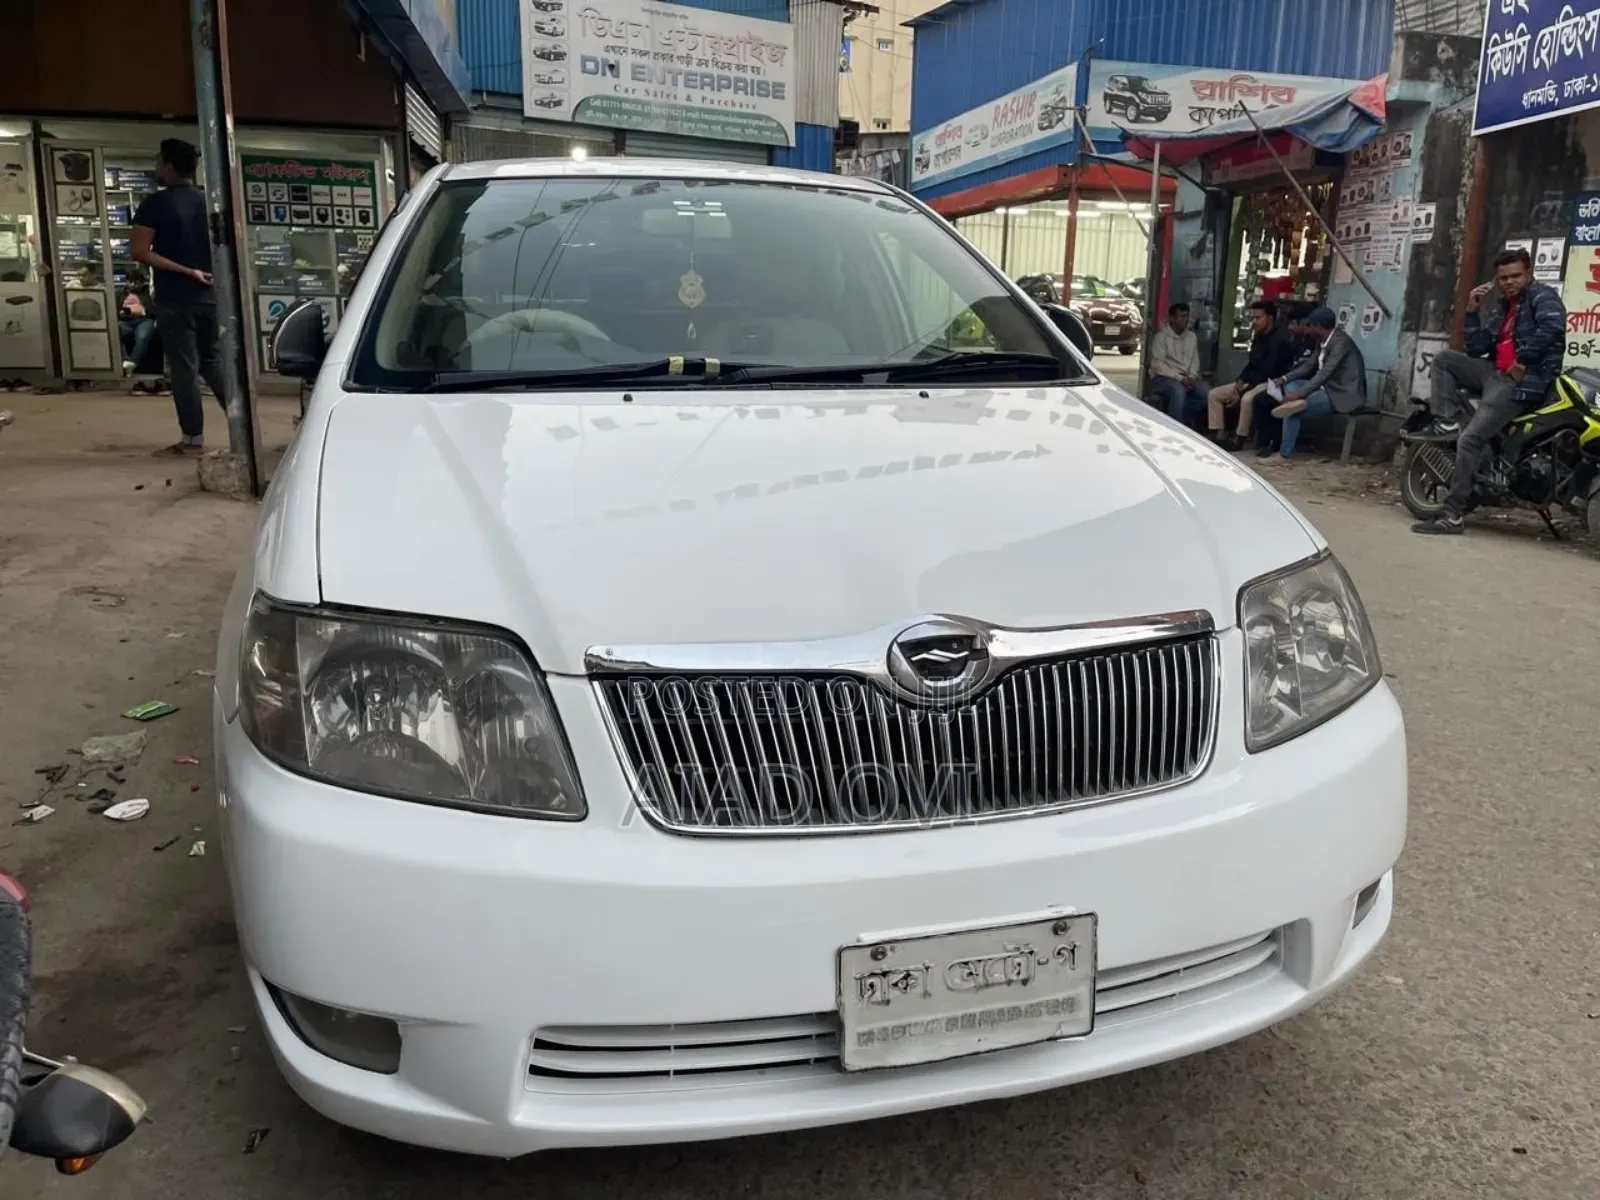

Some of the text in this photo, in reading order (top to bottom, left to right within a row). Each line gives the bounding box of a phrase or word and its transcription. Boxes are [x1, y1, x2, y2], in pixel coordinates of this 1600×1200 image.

[580, 55, 786, 101] DN ENTERPRISE
[614, 84, 637, 95] Car
[643, 88, 677, 99] Sales
[1190, 74, 1298, 105] রাশিব
[992, 91, 1037, 131] RASHIB
